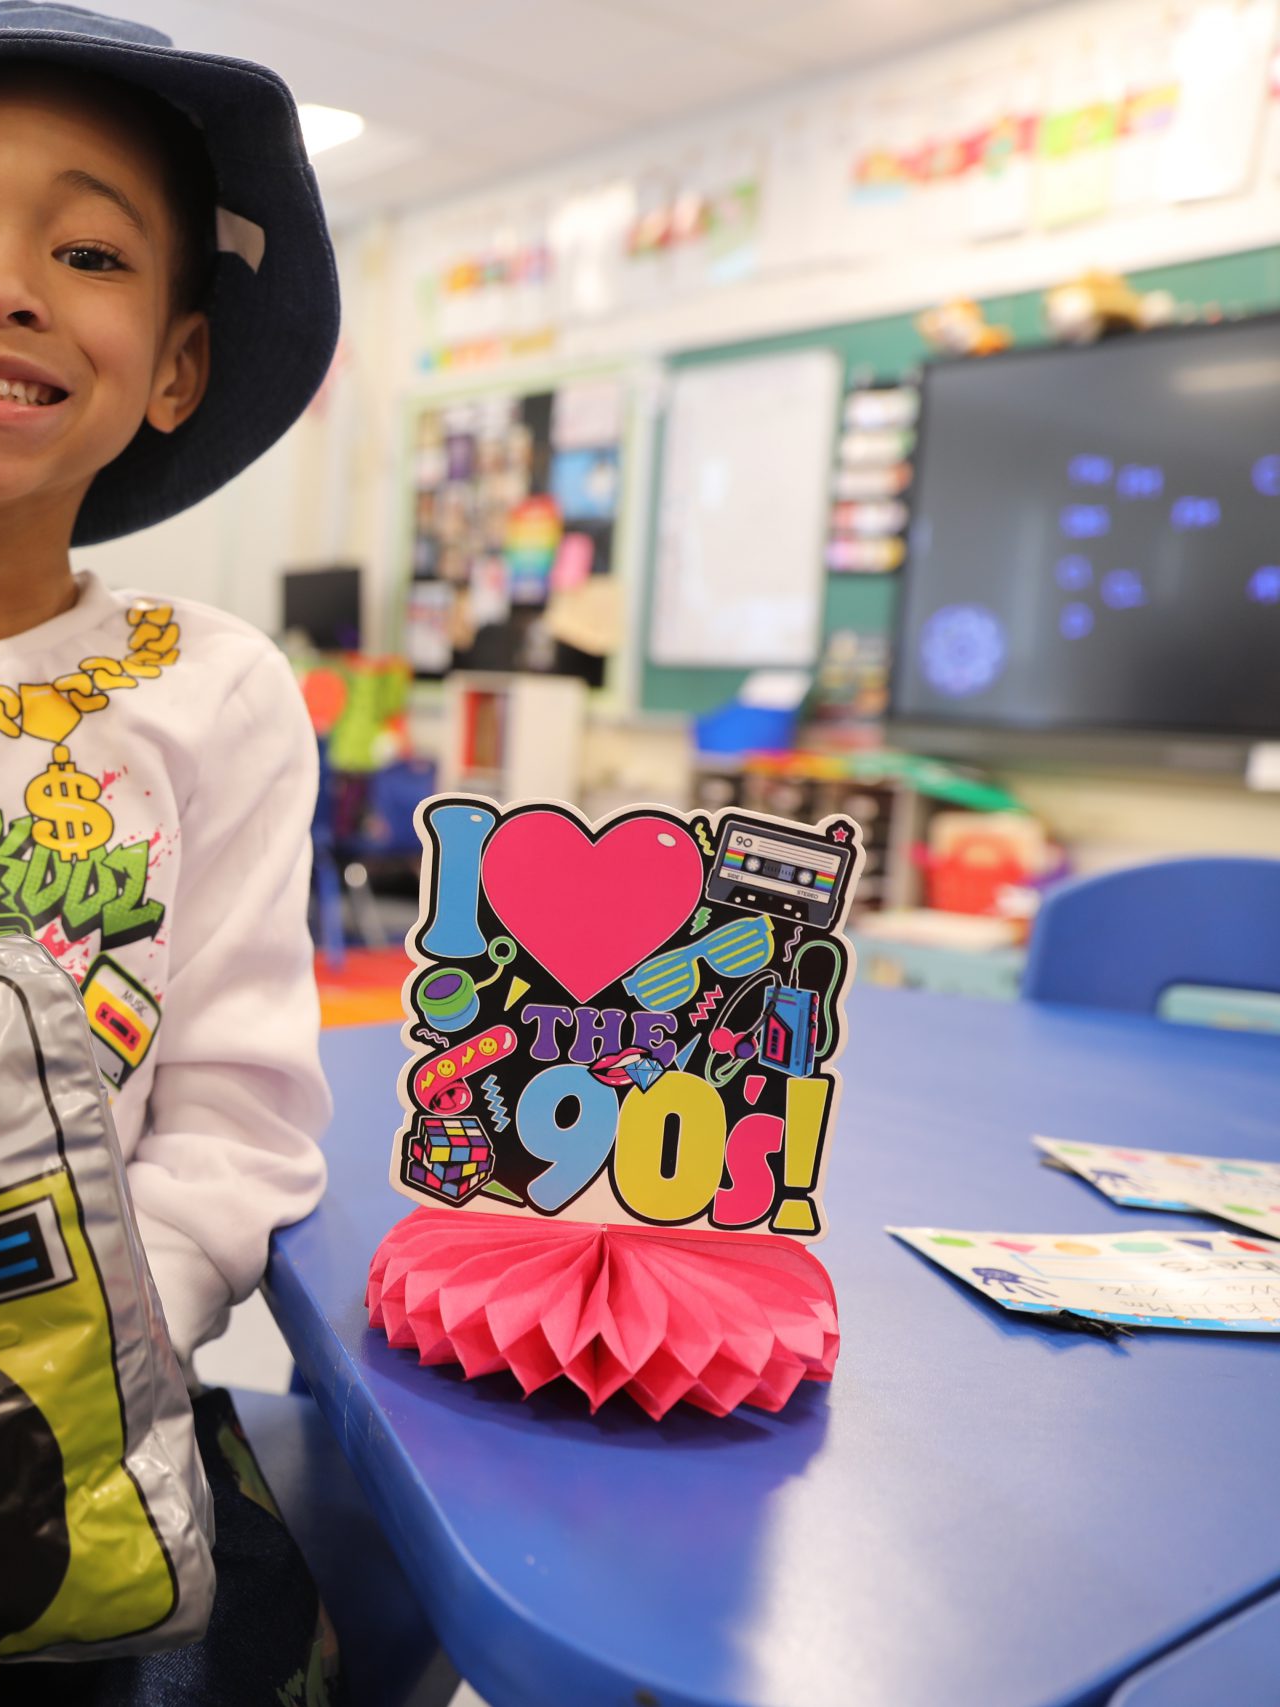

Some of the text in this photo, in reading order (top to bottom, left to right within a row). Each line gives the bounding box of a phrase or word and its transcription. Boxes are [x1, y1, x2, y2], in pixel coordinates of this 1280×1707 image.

[735, 836, 753, 848] 90
[422, 805, 496, 958] I
[727, 872, 740, 880] SIDE
[797, 889, 819, 899] STEREO
[521, 1003, 678, 1067] THE
